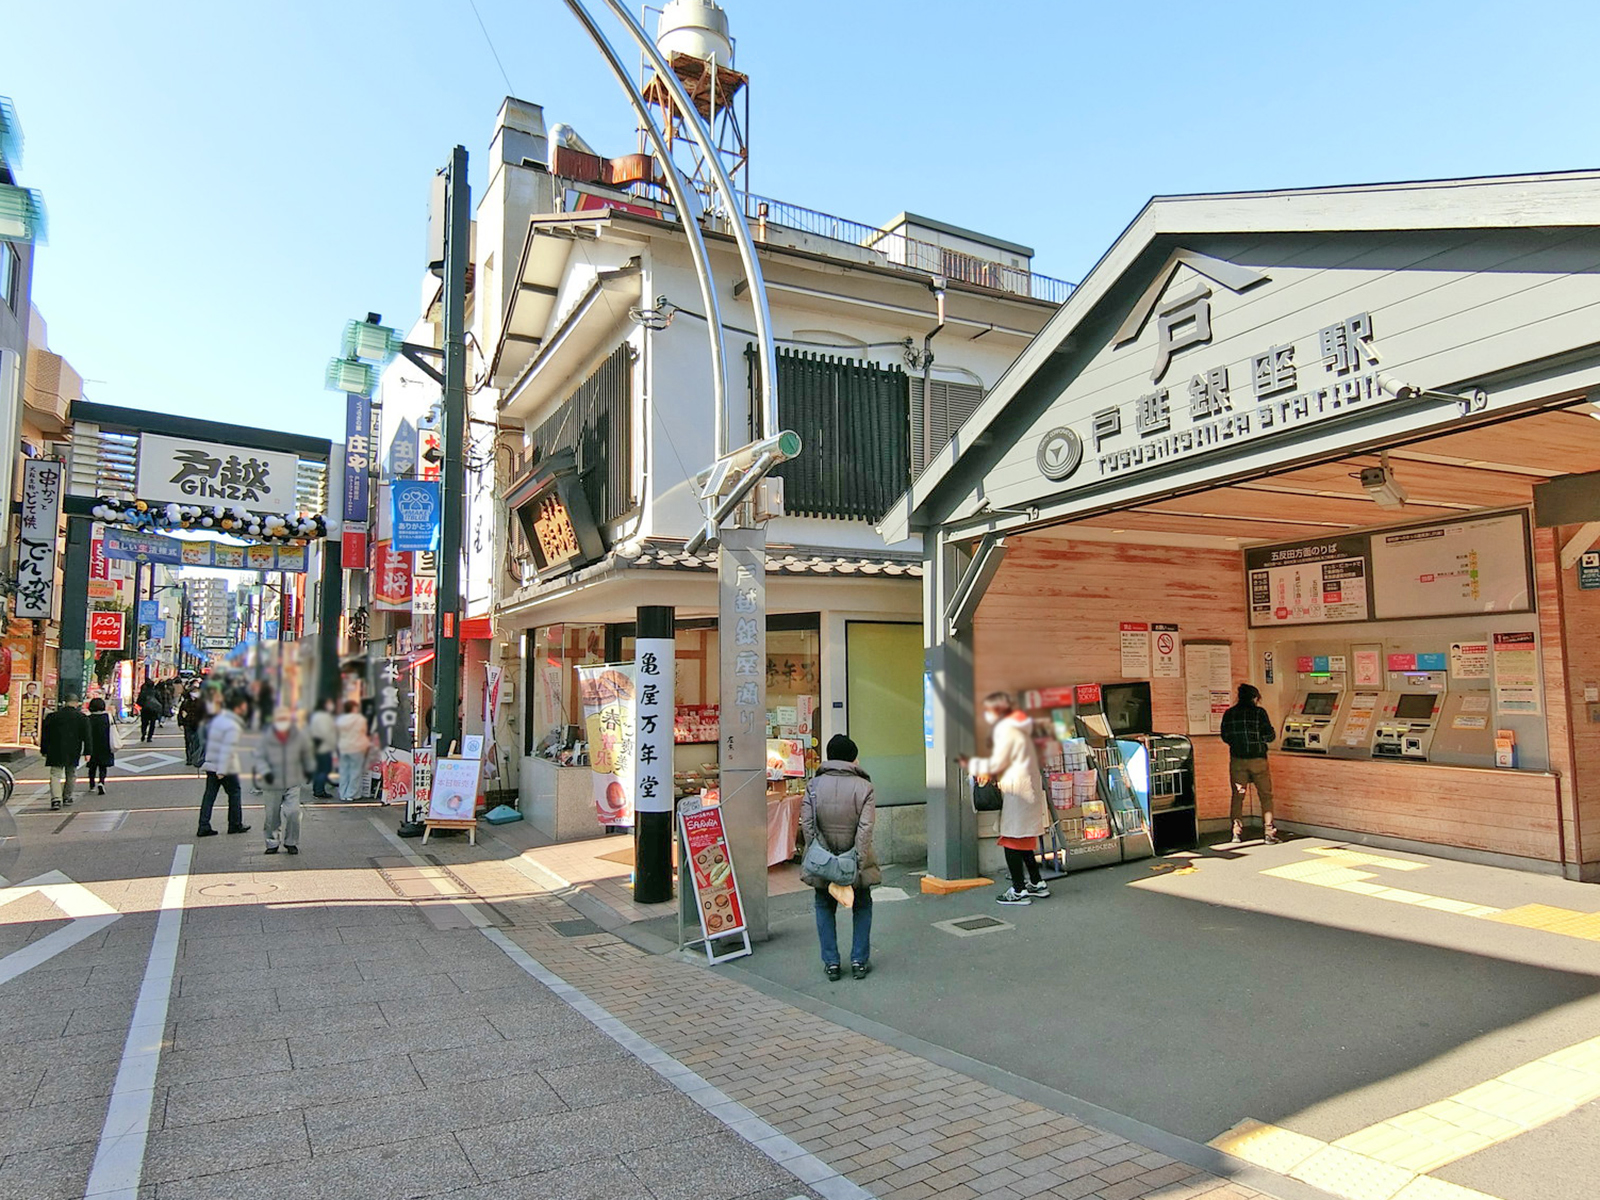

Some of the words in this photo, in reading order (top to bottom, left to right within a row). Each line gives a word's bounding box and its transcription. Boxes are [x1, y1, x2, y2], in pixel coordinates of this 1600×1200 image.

[1091, 311, 1384, 453] 戸越銀座駅
[1097, 415, 1252, 475] TOGOSHIGINZA
[1256, 373, 1384, 428] STATION
[169, 449, 272, 494] 戸越
[1271, 543, 1338, 561] 五反田方面のりば
[93, 616, 120, 629] 100円
[734, 563, 761, 735] 戸越銀座通り
[639, 652, 661, 798] 亀屋万年堂
